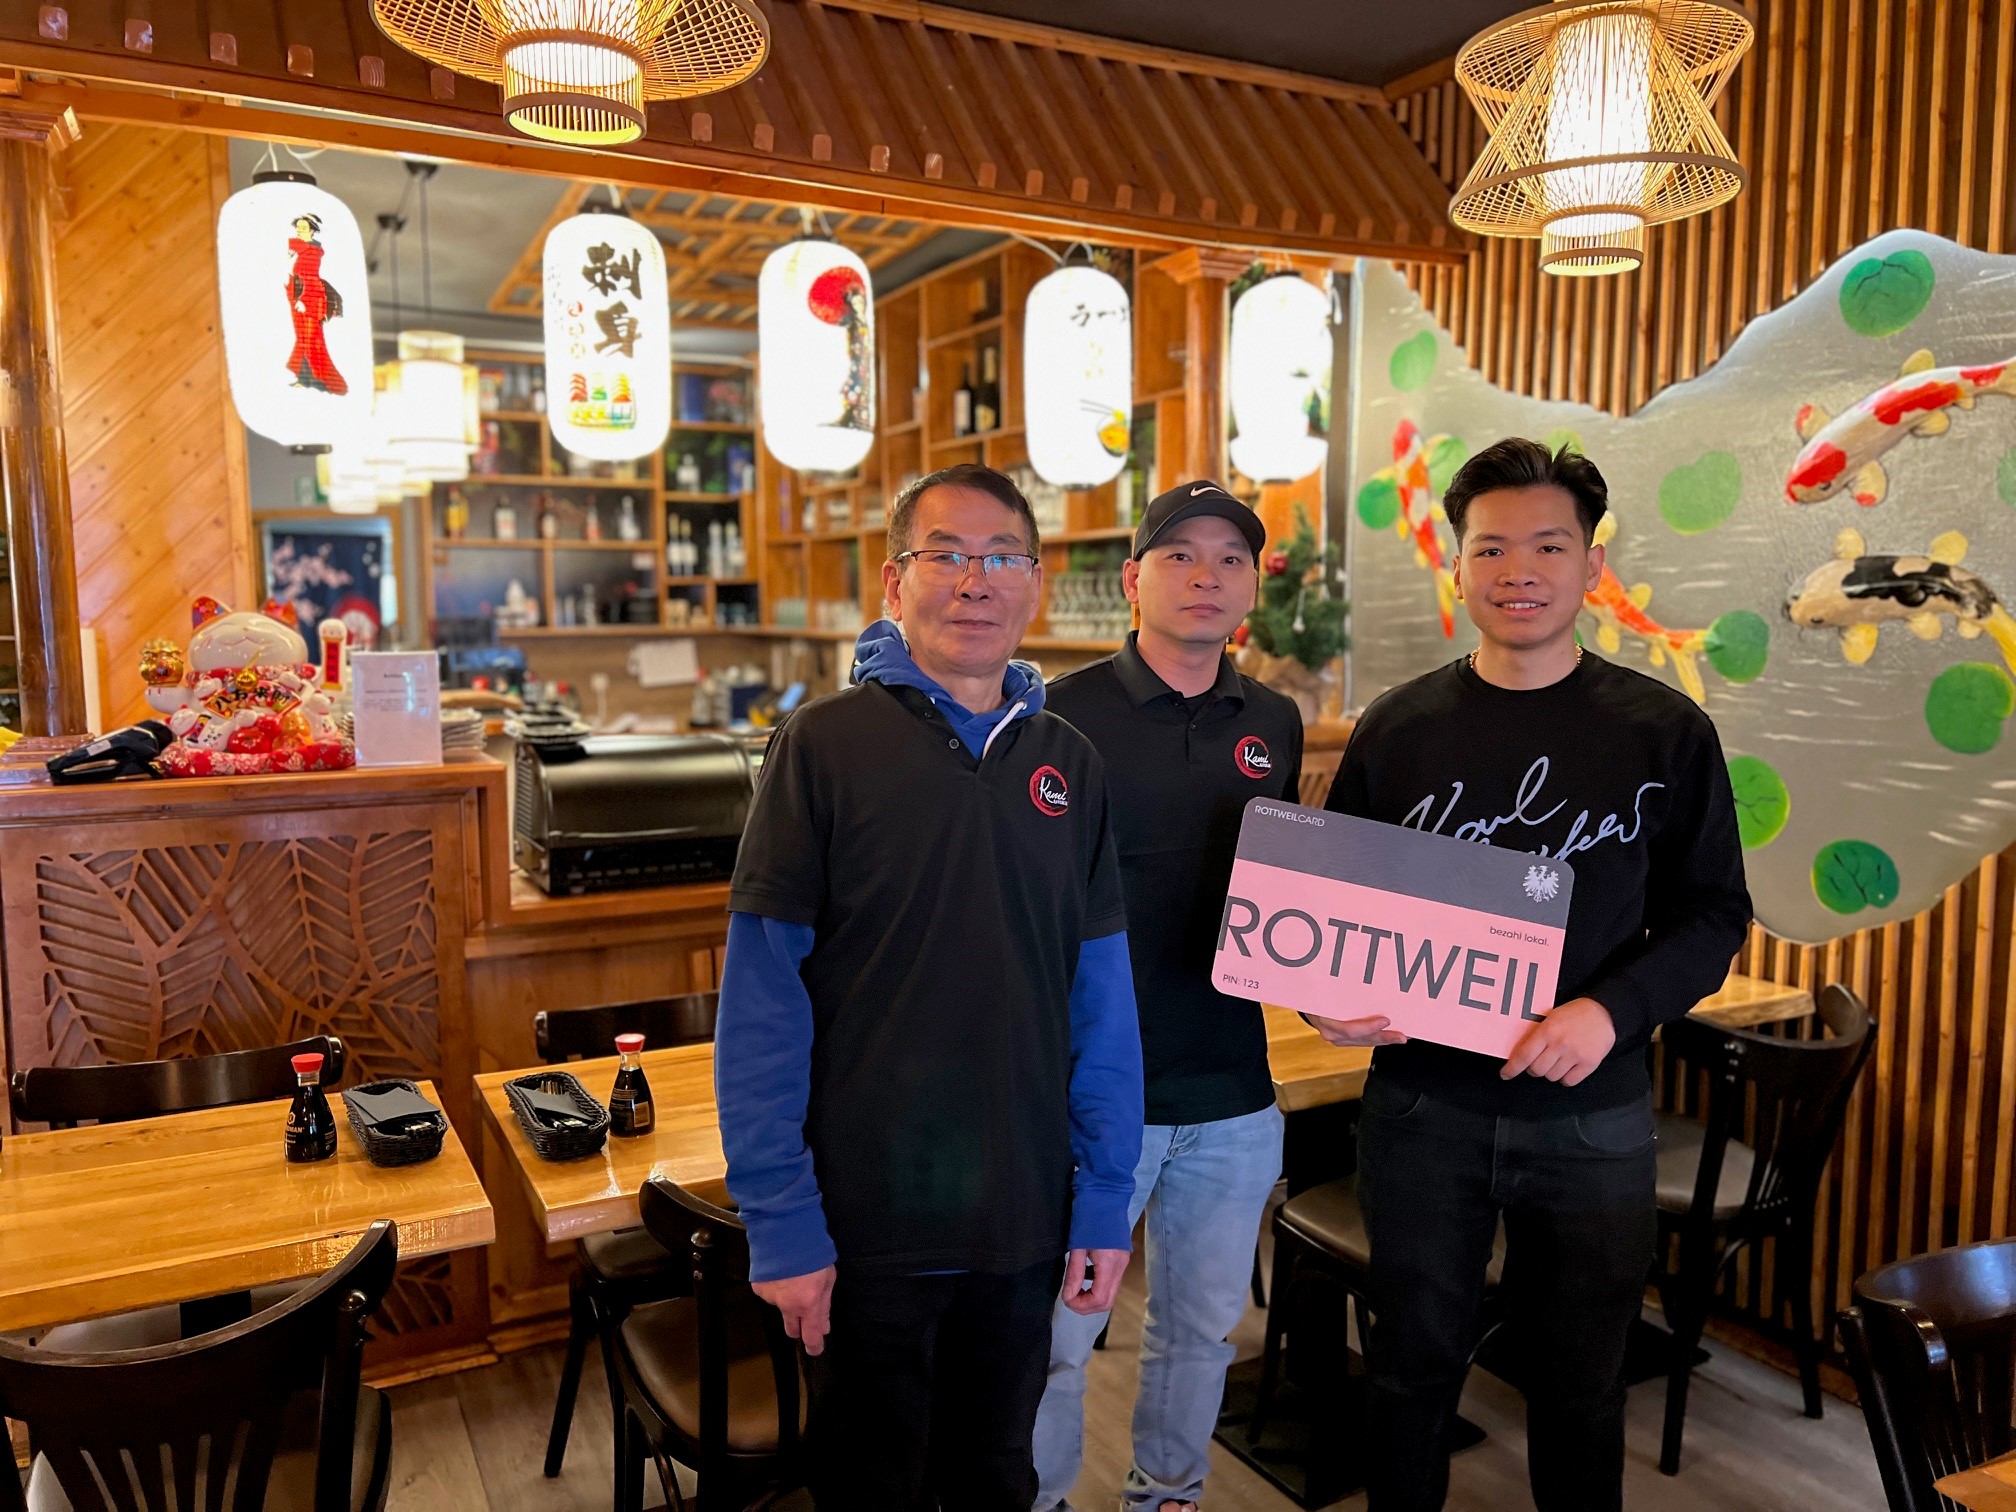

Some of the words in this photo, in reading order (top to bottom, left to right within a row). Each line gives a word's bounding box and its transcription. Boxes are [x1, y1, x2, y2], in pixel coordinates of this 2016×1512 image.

[582, 242, 642, 358] 刺身
[1254, 805, 1325, 827] ROTTWEILCARD
[1489, 926, 1522, 940] bezahl
[1218, 895, 1548, 1023] ROTTWEIL
[1243, 978, 1259, 989] 123
